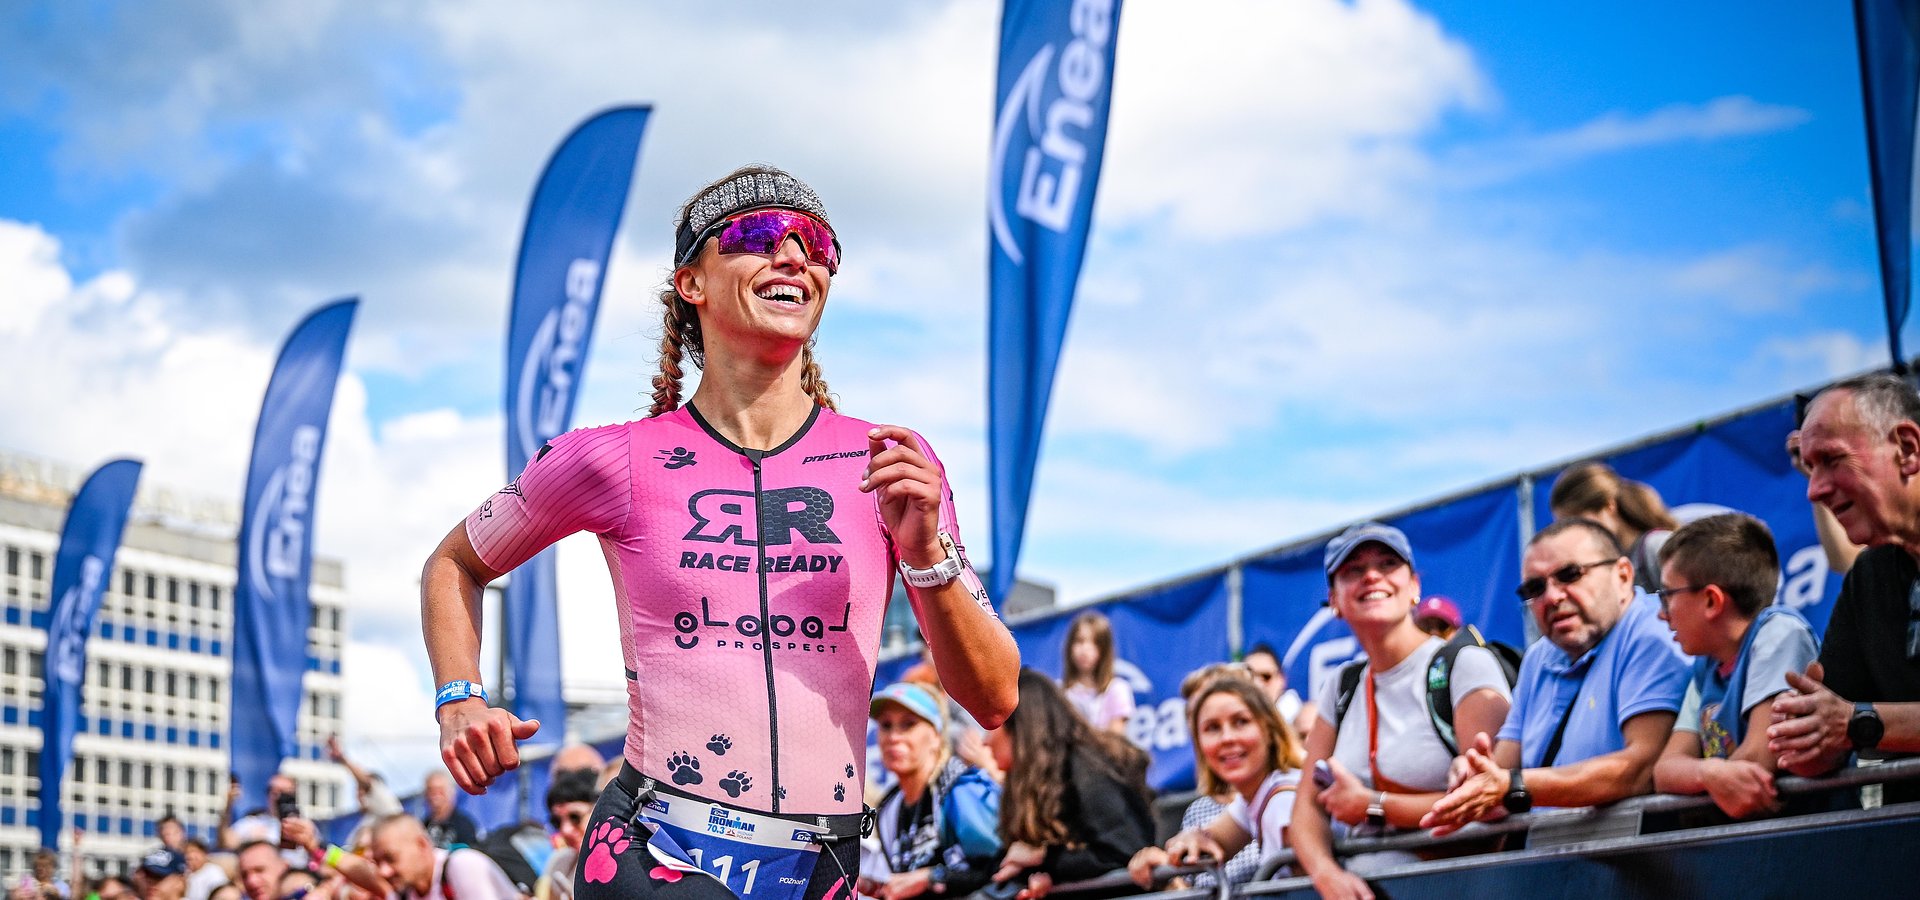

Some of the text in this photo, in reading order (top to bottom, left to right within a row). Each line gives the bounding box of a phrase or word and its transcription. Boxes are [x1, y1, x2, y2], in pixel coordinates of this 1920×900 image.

[1015, 0, 1113, 234] Enea
[266, 424, 321, 580] Enea
[679, 551, 844, 574] RACE READY
[717, 640, 837, 654] PROSPECT
[1125, 697, 1188, 751] ea
[707, 823, 725, 834] 70.3
[708, 815, 755, 832] IRONMAN
